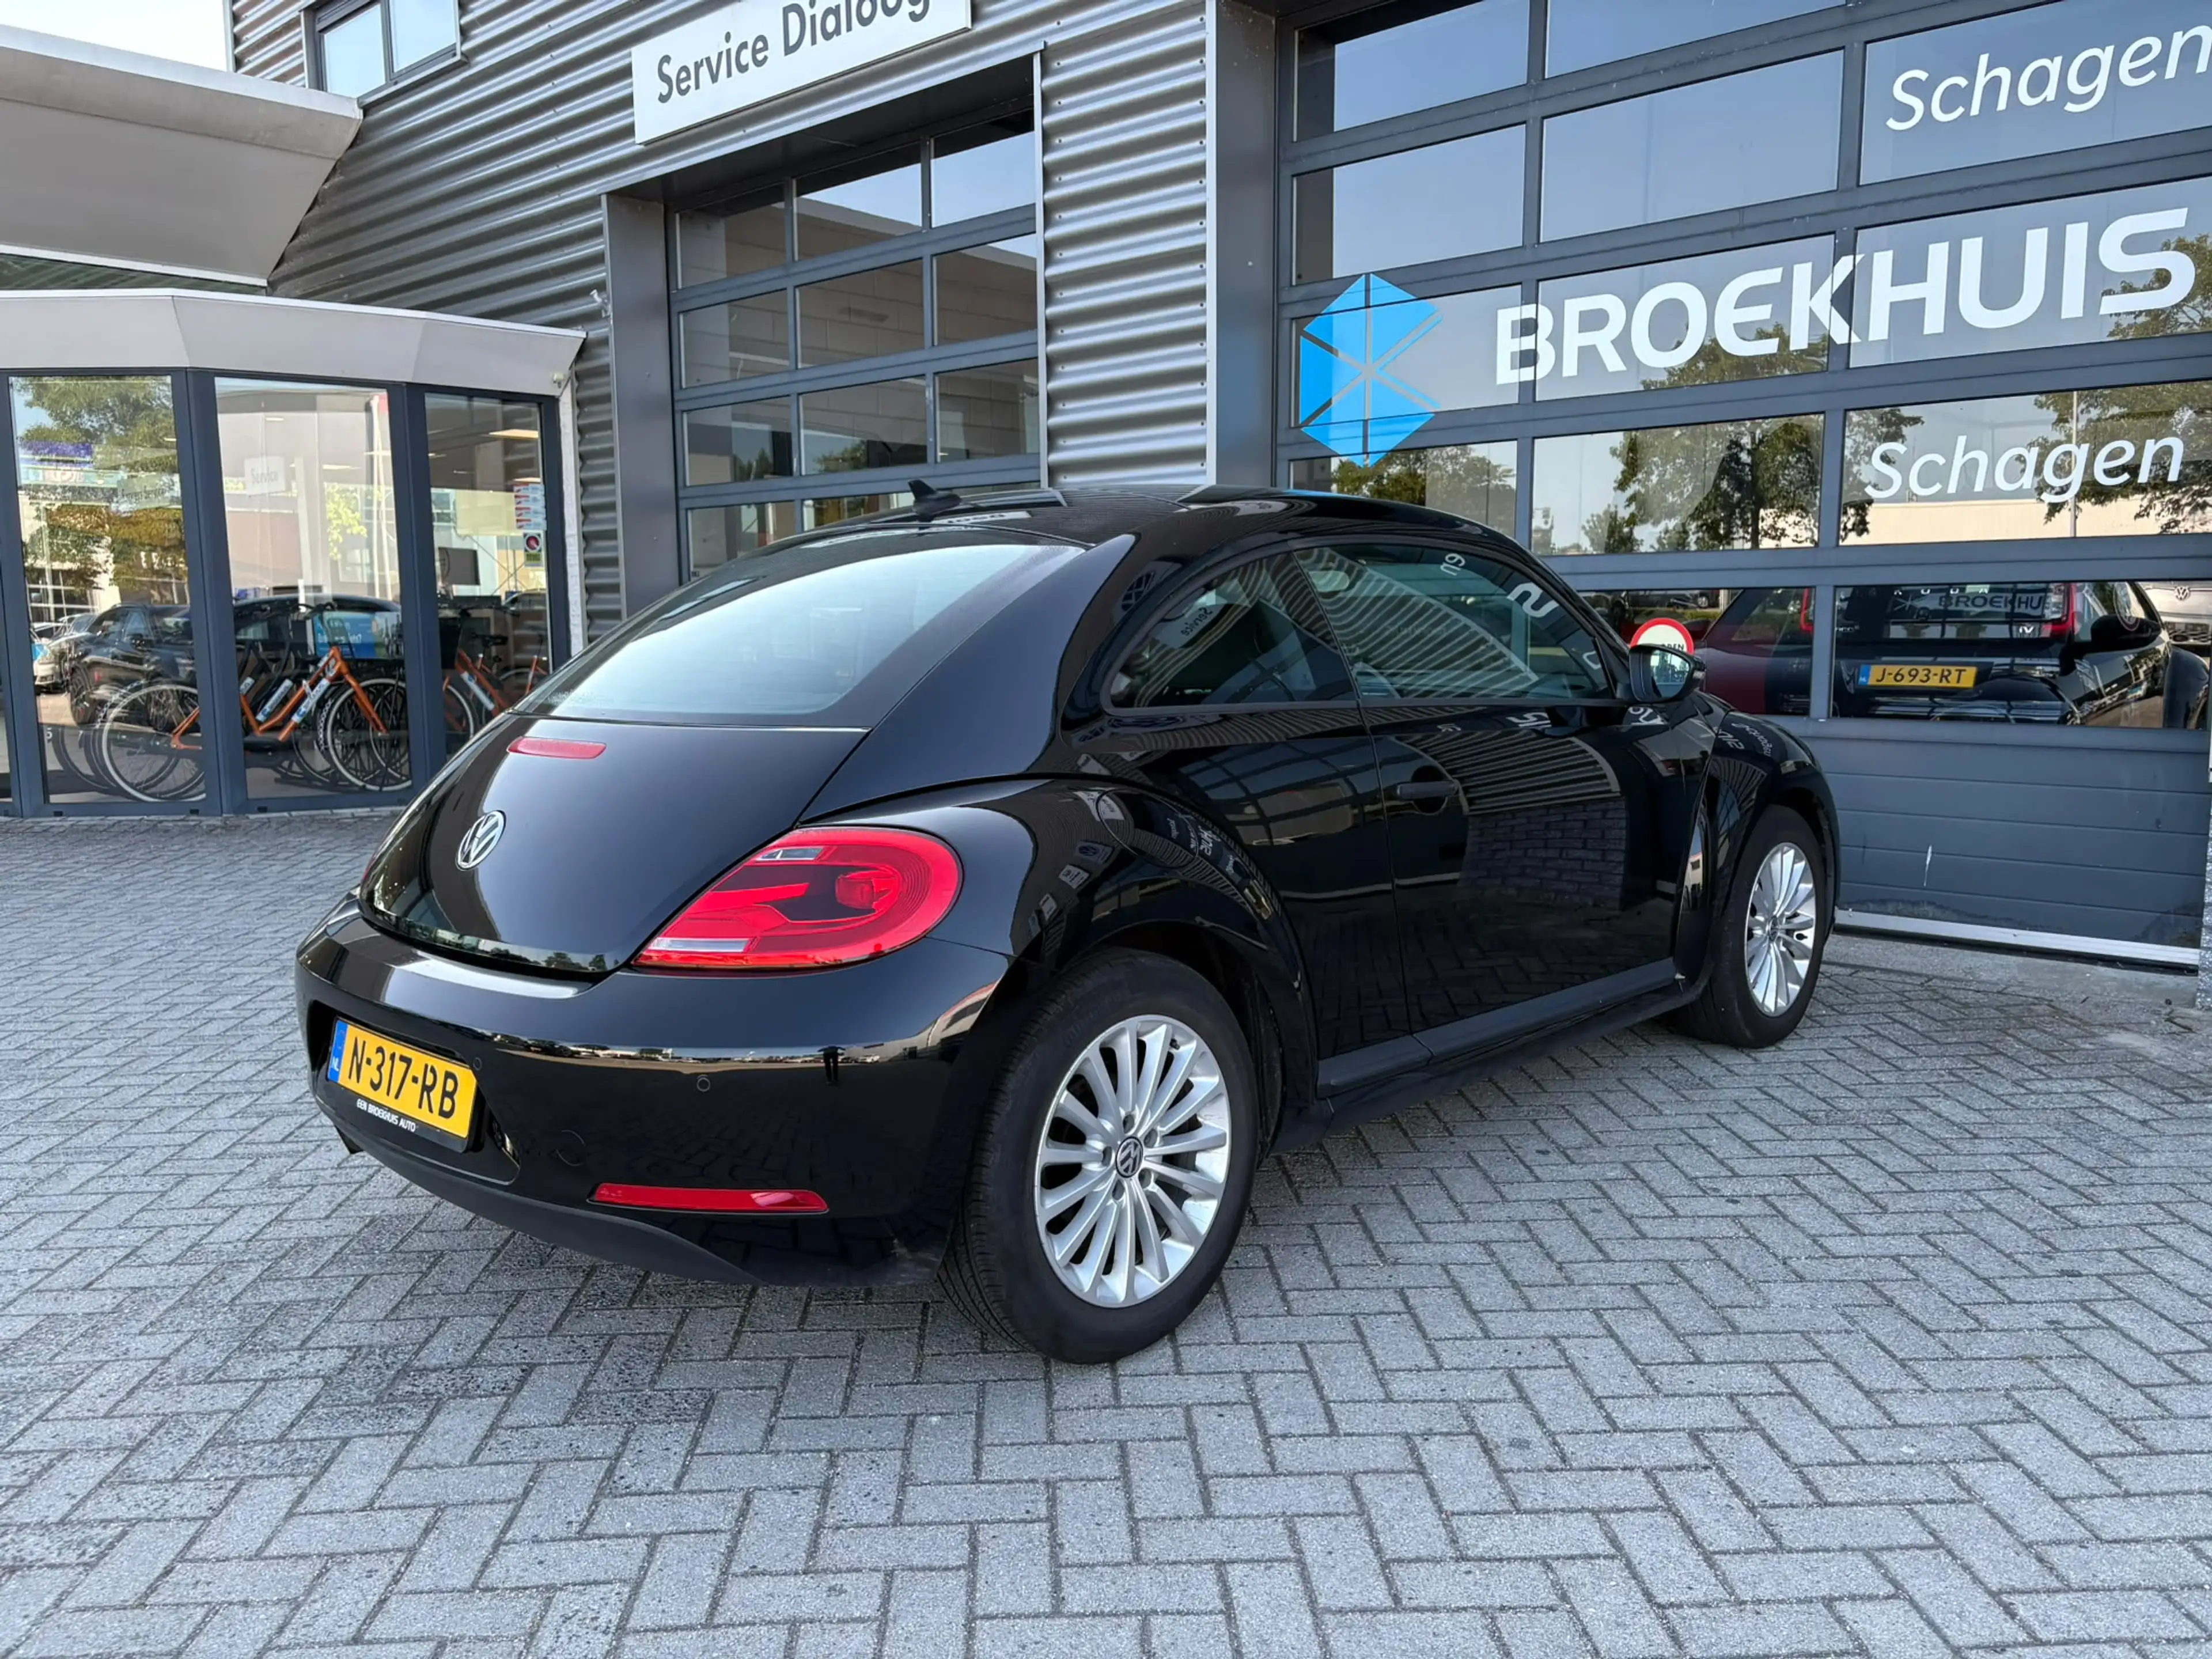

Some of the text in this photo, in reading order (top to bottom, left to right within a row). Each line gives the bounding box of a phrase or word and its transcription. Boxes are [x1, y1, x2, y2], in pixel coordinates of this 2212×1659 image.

[657, 0, 930, 104] Service Dialoog
[1886, 24, 2212, 131] Schagen
[1495, 208, 2195, 385] BROEKHUIS
[1866, 435, 2183, 504] Schagen
[1876, 667, 1967, 684] J-693-RT
[331, 1056, 340, 1072] NL
[348, 1036, 459, 1119] N-317-RB
[399, 1118, 416, 1132] AUTO
